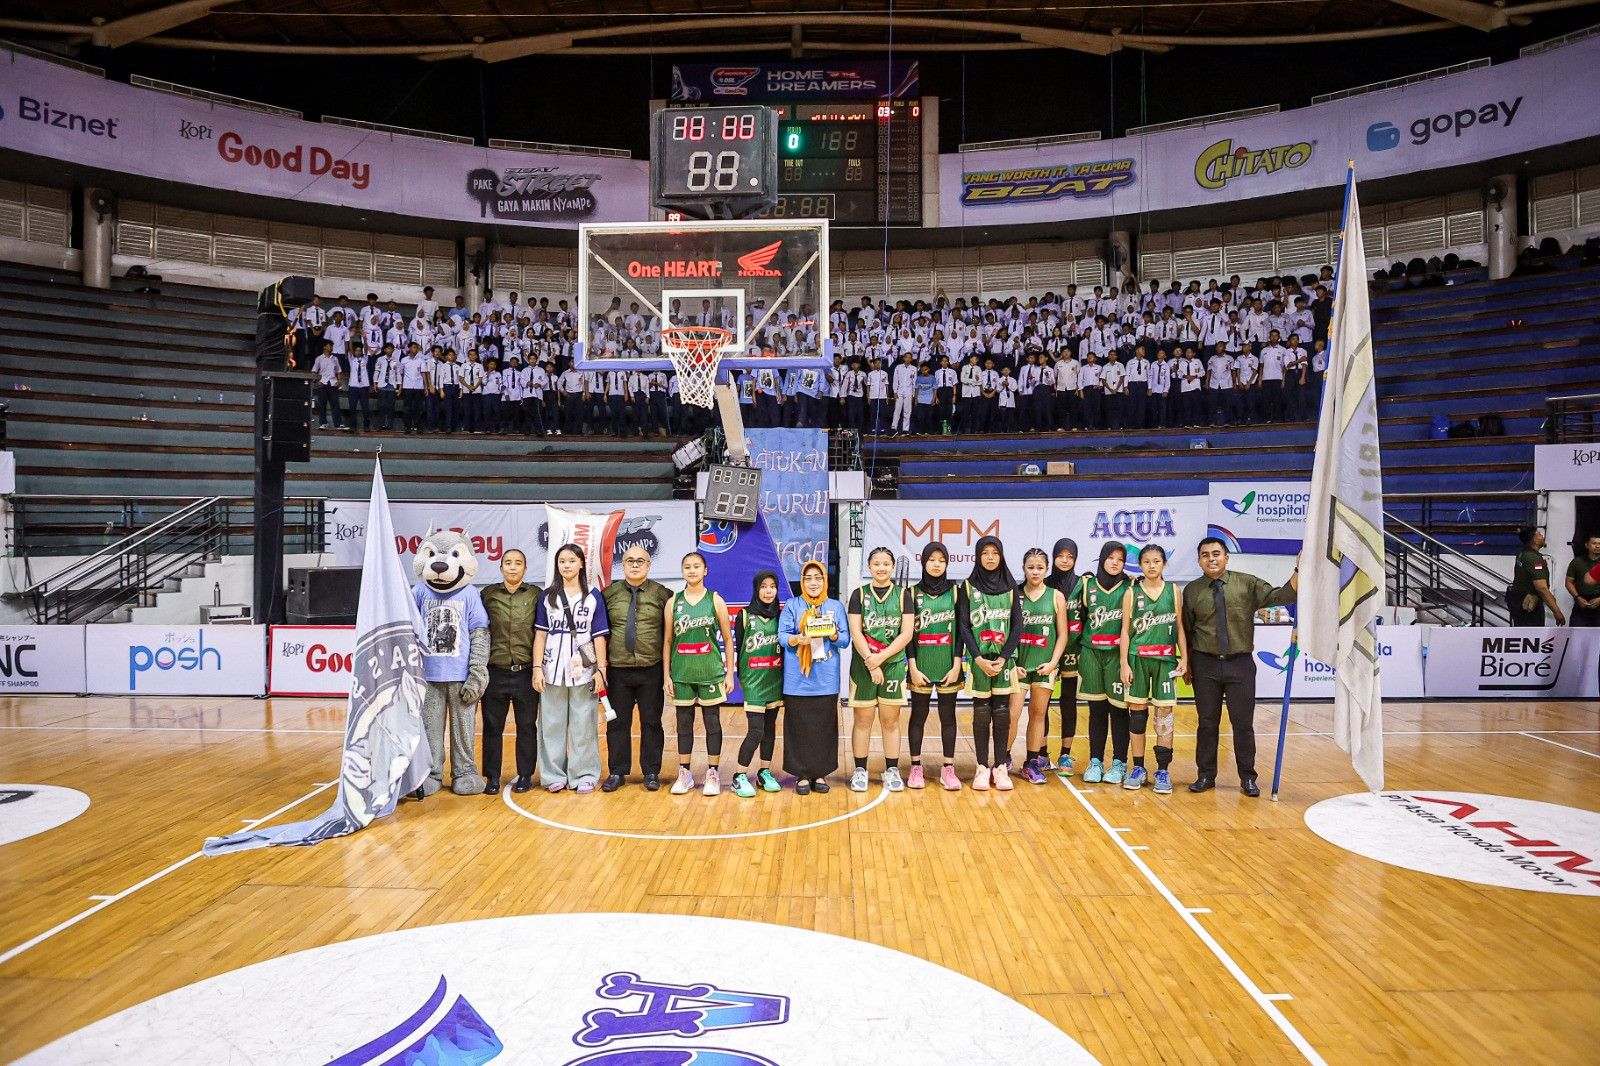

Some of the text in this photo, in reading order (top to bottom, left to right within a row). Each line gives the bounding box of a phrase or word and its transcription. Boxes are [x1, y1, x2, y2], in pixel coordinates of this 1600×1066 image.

[767, 71, 824, 81] HOME
[767, 80, 877, 92] DREAMERS
[19, 96, 118, 139] Biznet
[1410, 96, 1523, 145] gopay
[788, 134, 799, 149] 0
[217, 131, 371, 190] Good Day
[964, 173, 1000, 184] YANG
[1001, 169, 1051, 181] WORTH
[1073, 164, 1091, 176] YA
[1092, 159, 1132, 174] CUMA
[473, 179, 493, 190] PAKE
[498, 200, 520, 212] GAYA
[521, 199, 551, 212] MAKIN
[628, 260, 661, 278] One
[738, 269, 782, 277] HONDA
[1257, 493, 1311, 505] mayapa
[1257, 504, 1305, 517] hospital
[902, 518, 1000, 547] MPM
[1089, 508, 1176, 544] AQUA
[577, 606, 589, 617] 29
[130, 629, 221, 690] posh
[306, 643, 354, 674] Goo
[1064, 653, 1077, 666] 23
[1480, 655, 1552, 678] Bioré
[1004, 668, 1010, 681] 8
[886, 679, 899, 692] 27
[1112, 682, 1123, 694] 15
[1162, 681, 1171, 693] 11
[1381, 794, 1578, 888] PT Astra Honda Motor
